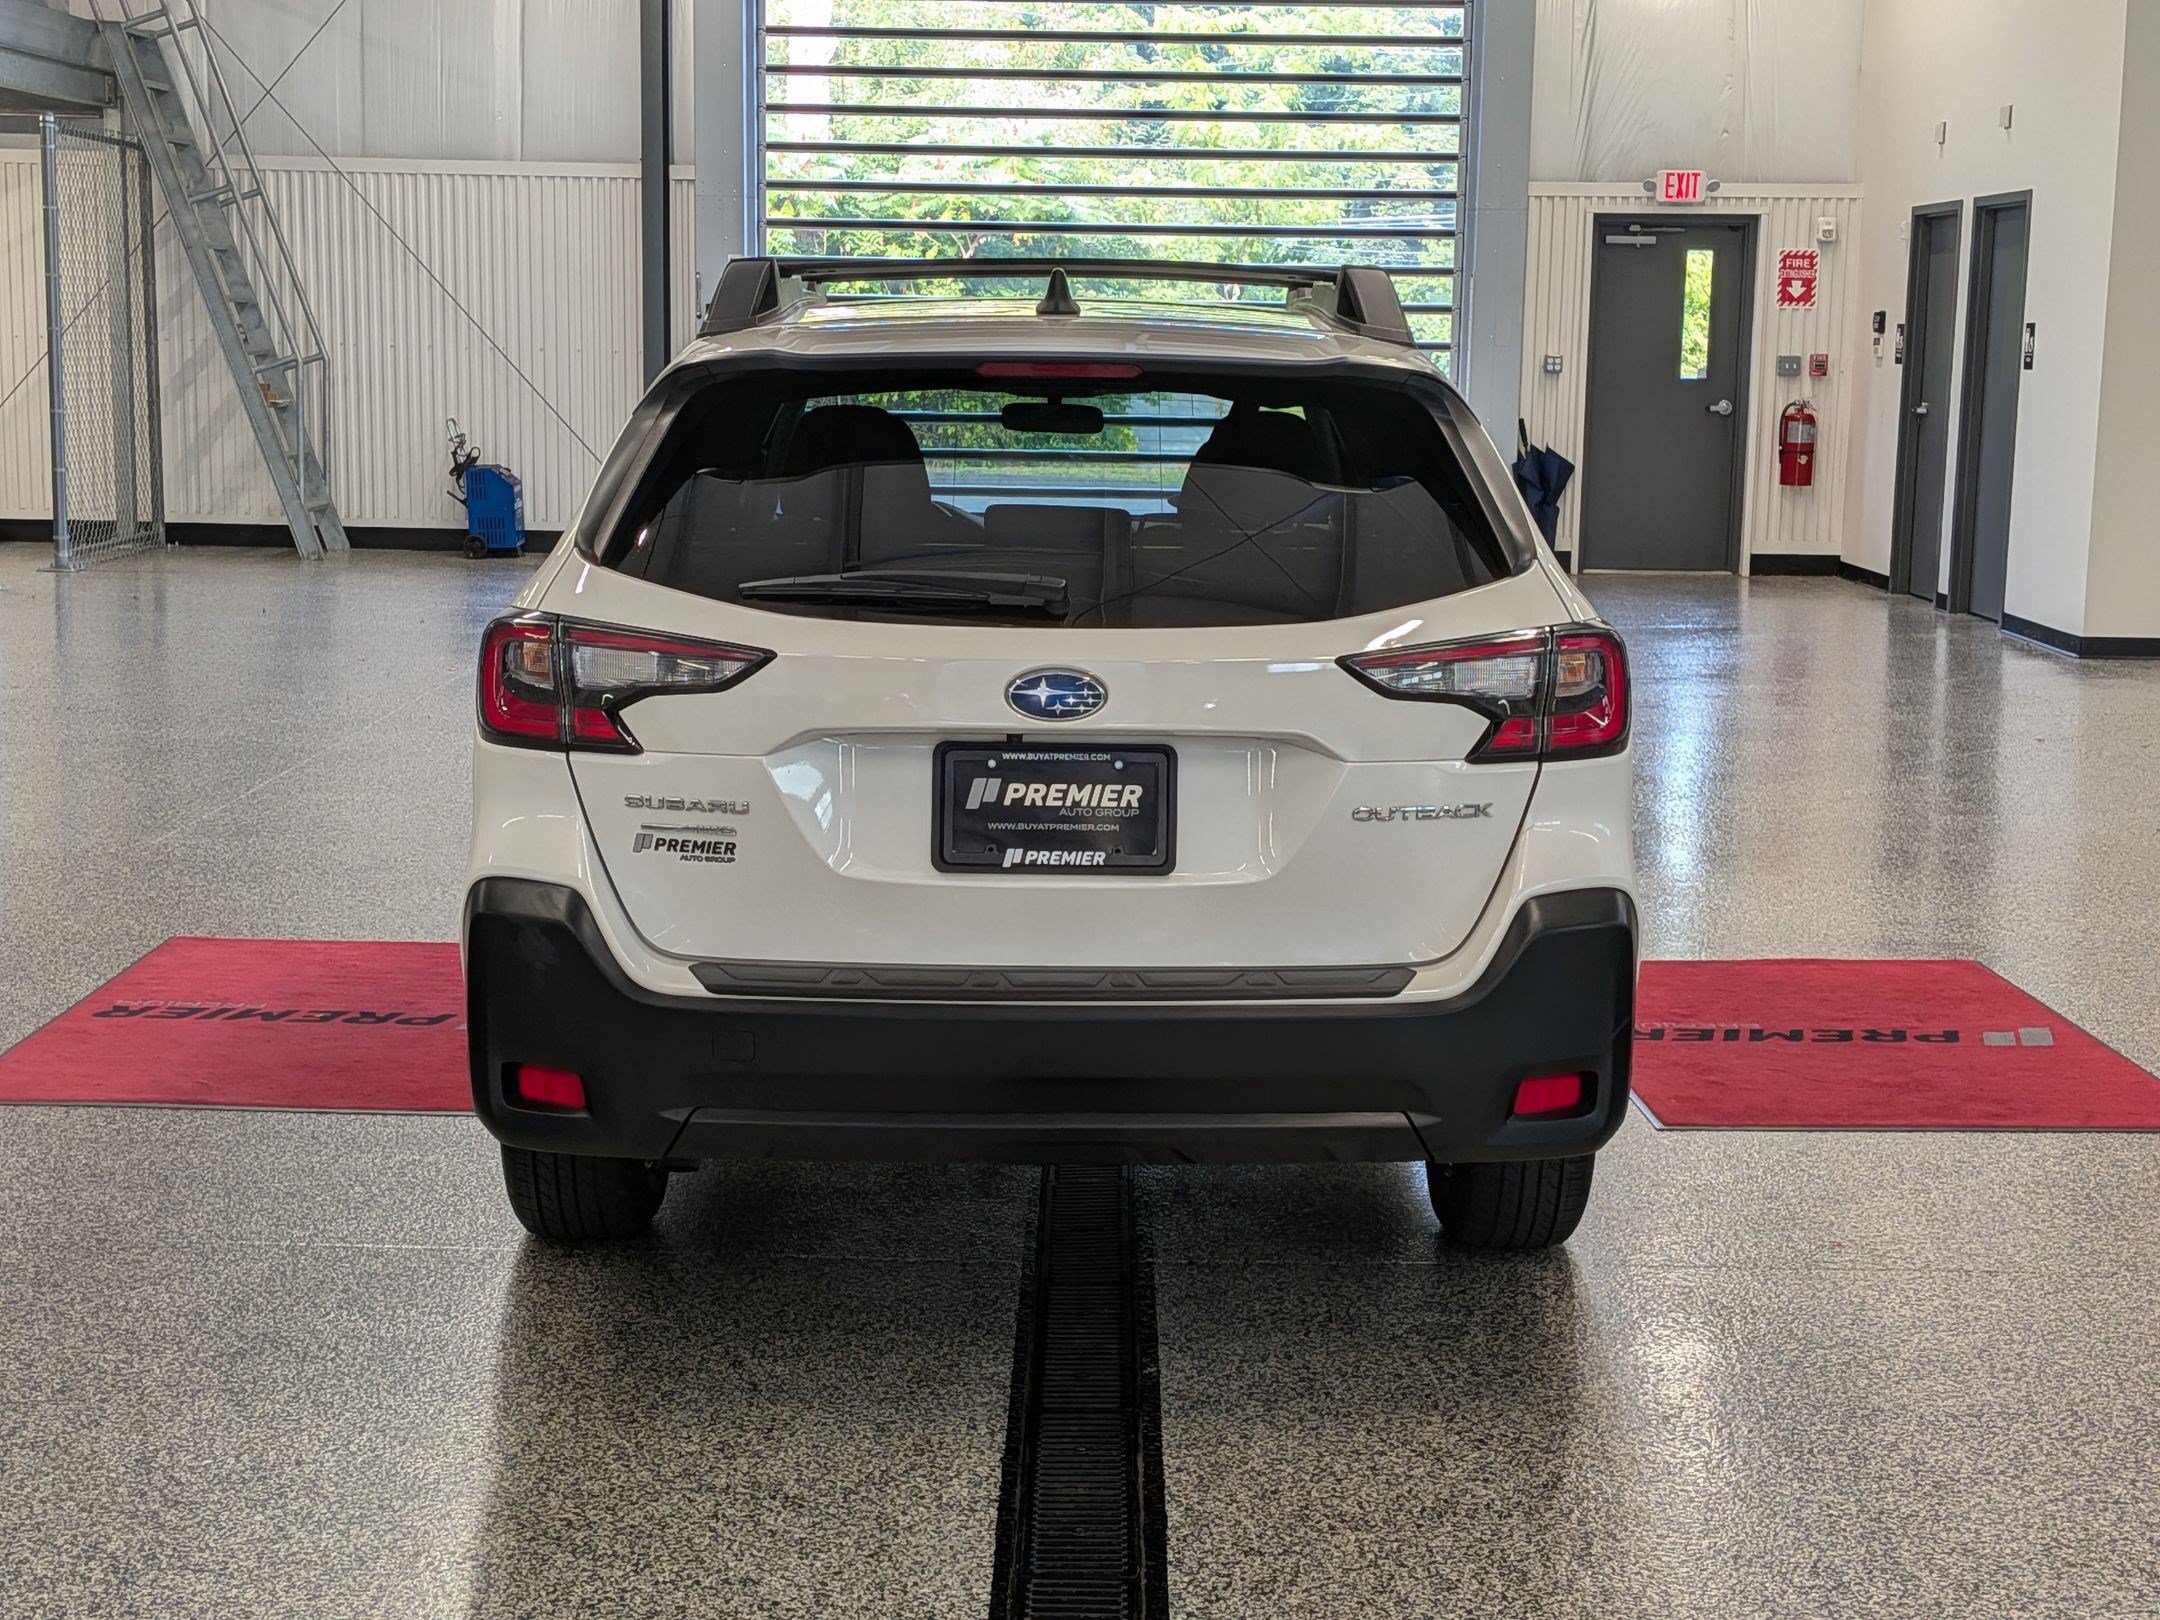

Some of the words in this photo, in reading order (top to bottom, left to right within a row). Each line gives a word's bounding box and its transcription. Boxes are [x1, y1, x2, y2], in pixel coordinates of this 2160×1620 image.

[1664, 172, 1701, 200] EXIT
[1785, 258, 1811, 268] FIRE
[1001, 752, 1111, 761] WWW.BUYATPREMIER.COM
[1003, 783, 1143, 808] PREMIER
[624, 794, 750, 815] SUBARU
[1059, 807, 1093, 817] AUTO
[1095, 808, 1140, 817] GROUP
[1352, 802, 1494, 822] OUTBACK
[987, 822, 1120, 832] WWW.BUYATPREMIER.COM
[653, 837, 737, 856] PREMIER
[679, 854, 703, 863] AUTO
[704, 855, 737, 864] GROUP
[1024, 850, 1106, 866] PREMIER
[92, 1005, 458, 1026] PREMIER
